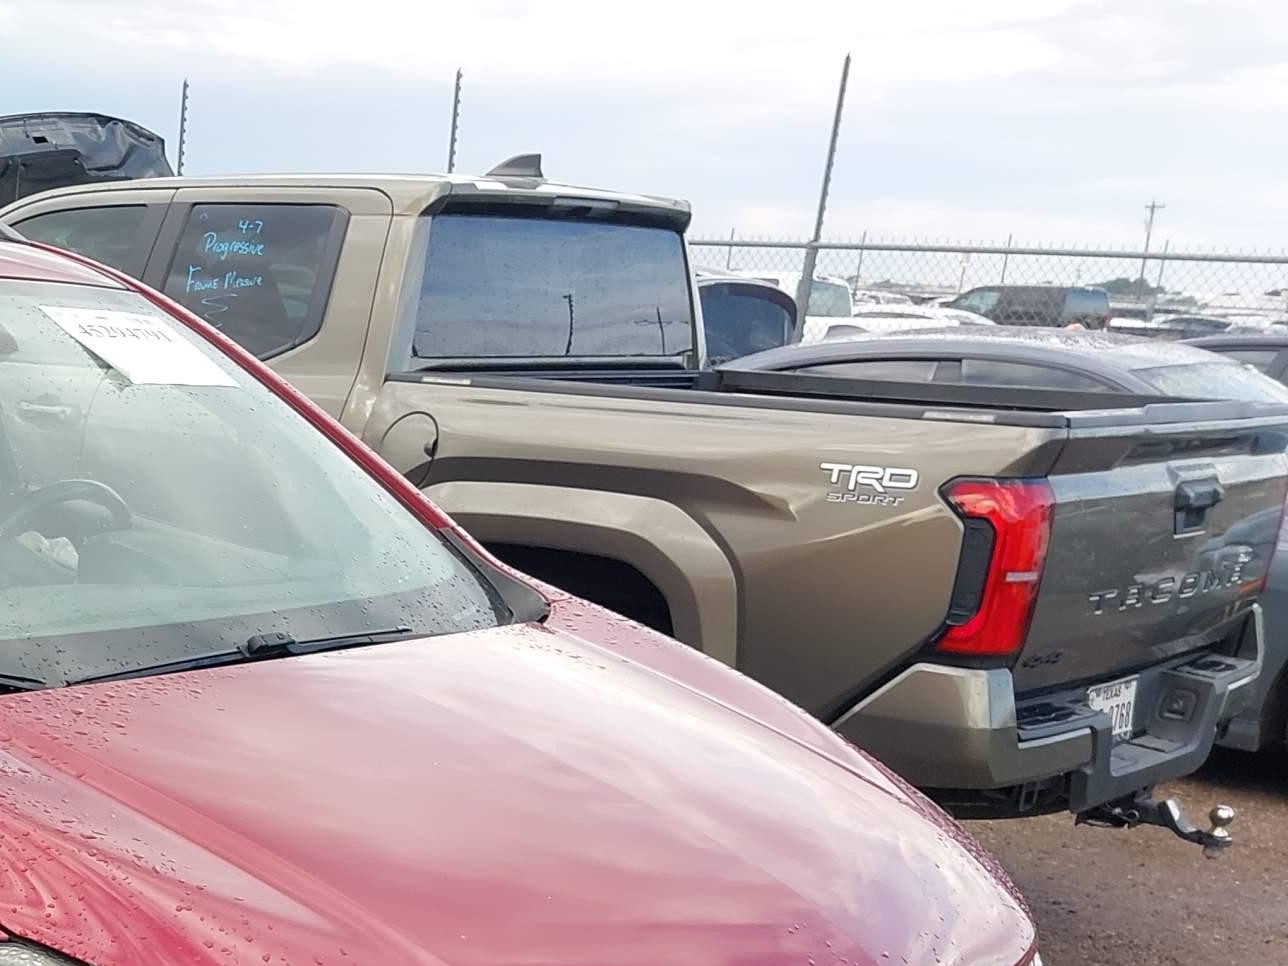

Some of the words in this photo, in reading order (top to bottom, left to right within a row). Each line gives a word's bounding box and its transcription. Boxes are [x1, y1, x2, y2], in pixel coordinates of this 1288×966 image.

[238, 219, 263, 234] 4-7
[203, 231, 264, 260] Progressive
[820, 462, 919, 493] TRD
[827, 492, 905, 506] SPORT
[1088, 560, 1245, 615] TACOMA
[1102, 684, 1122, 701] TEXAS
